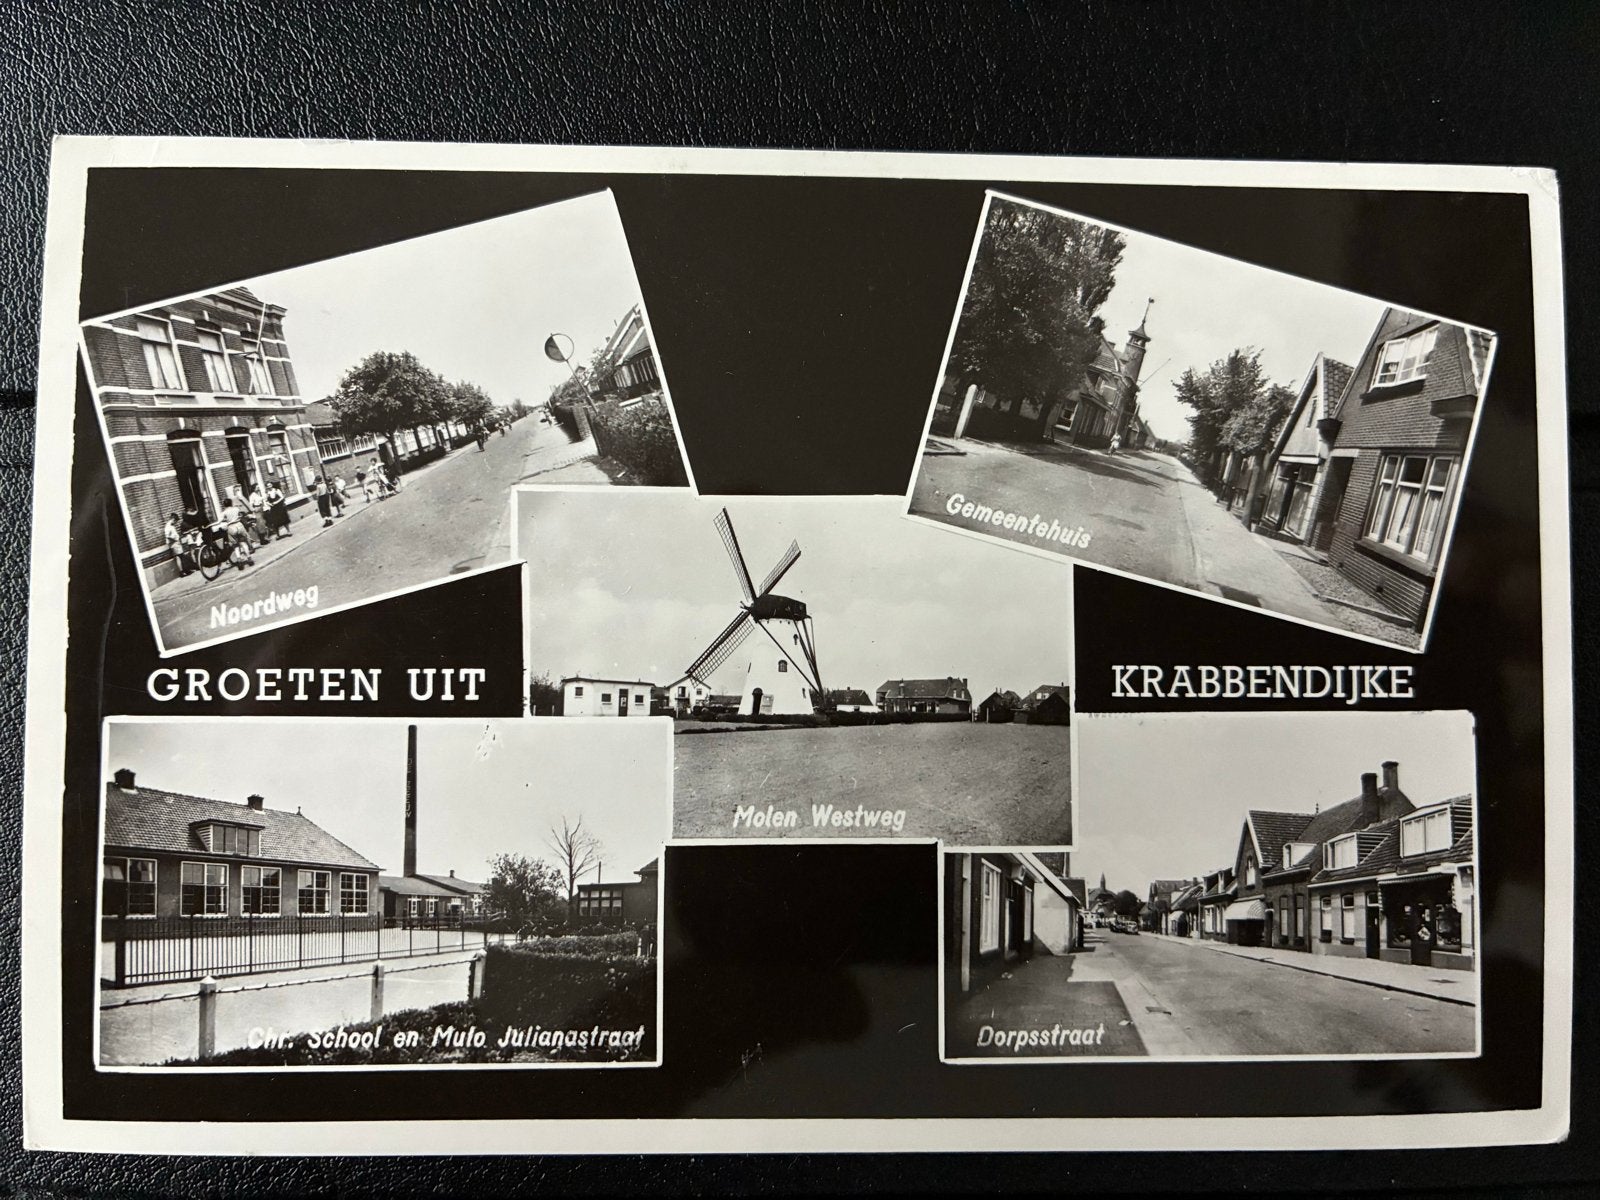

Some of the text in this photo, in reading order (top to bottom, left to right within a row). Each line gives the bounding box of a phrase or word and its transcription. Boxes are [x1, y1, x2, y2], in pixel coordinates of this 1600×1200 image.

[946, 493, 1092, 548] Gemeentehuis
[210, 585, 319, 629] Noordweg
[147, 664, 1416, 706] GROETEN UIT KRABBENDIJKE
[732, 803, 906, 831] Molen Westweg
[248, 1024, 645, 1049] Chr. School en Mulo Julianastraat
[977, 1022, 1105, 1053] Dorpsstraat
